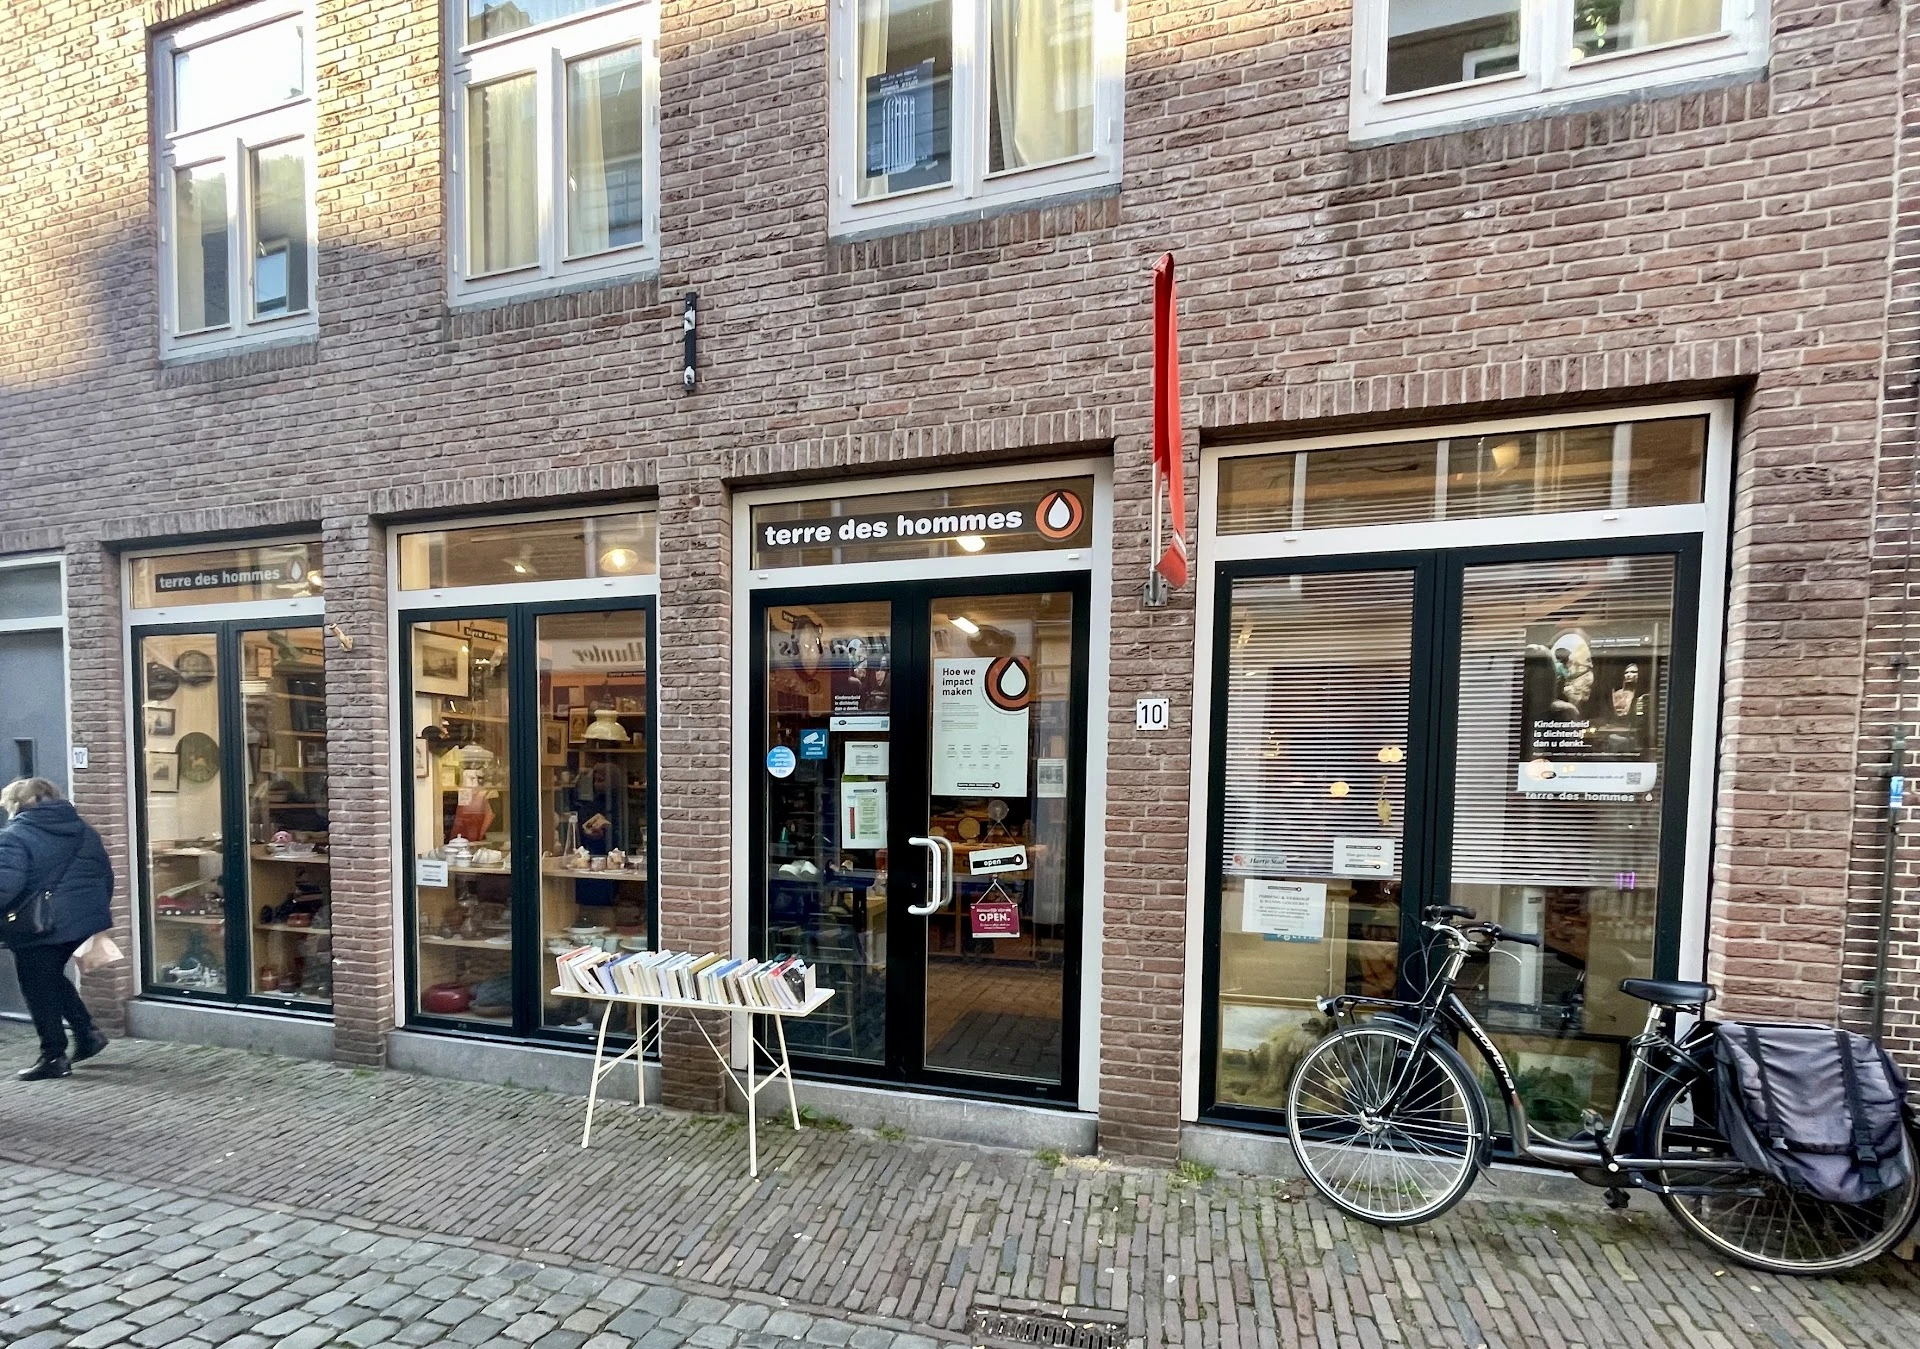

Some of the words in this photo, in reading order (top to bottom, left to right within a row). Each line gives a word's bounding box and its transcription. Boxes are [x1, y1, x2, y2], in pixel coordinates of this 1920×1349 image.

[765, 526, 832, 546] terre
[838, 518, 888, 541] des
[897, 510, 1023, 536] hommes
[159, 576, 192, 589] terre
[194, 573, 218, 586] des
[222, 568, 280, 584] hommes
[942, 667, 961, 676] Hoe
[963, 668, 976, 676] we
[942, 677, 974, 687] impact
[942, 687, 973, 696] maken
[1141, 704, 1162, 724] 10
[1533, 720, 1590, 728] Kinderarbeid
[1533, 729, 1542, 738] is
[1543, 729, 1585, 739] dichterbij
[1532, 740, 1550, 748] dan
[1525, 791, 1555, 800] terre
[1558, 792, 1580, 801] des
[1584, 792, 1635, 802] hommes
[983, 859, 1002, 867] open
[978, 913, 1011, 922] OPEN.
